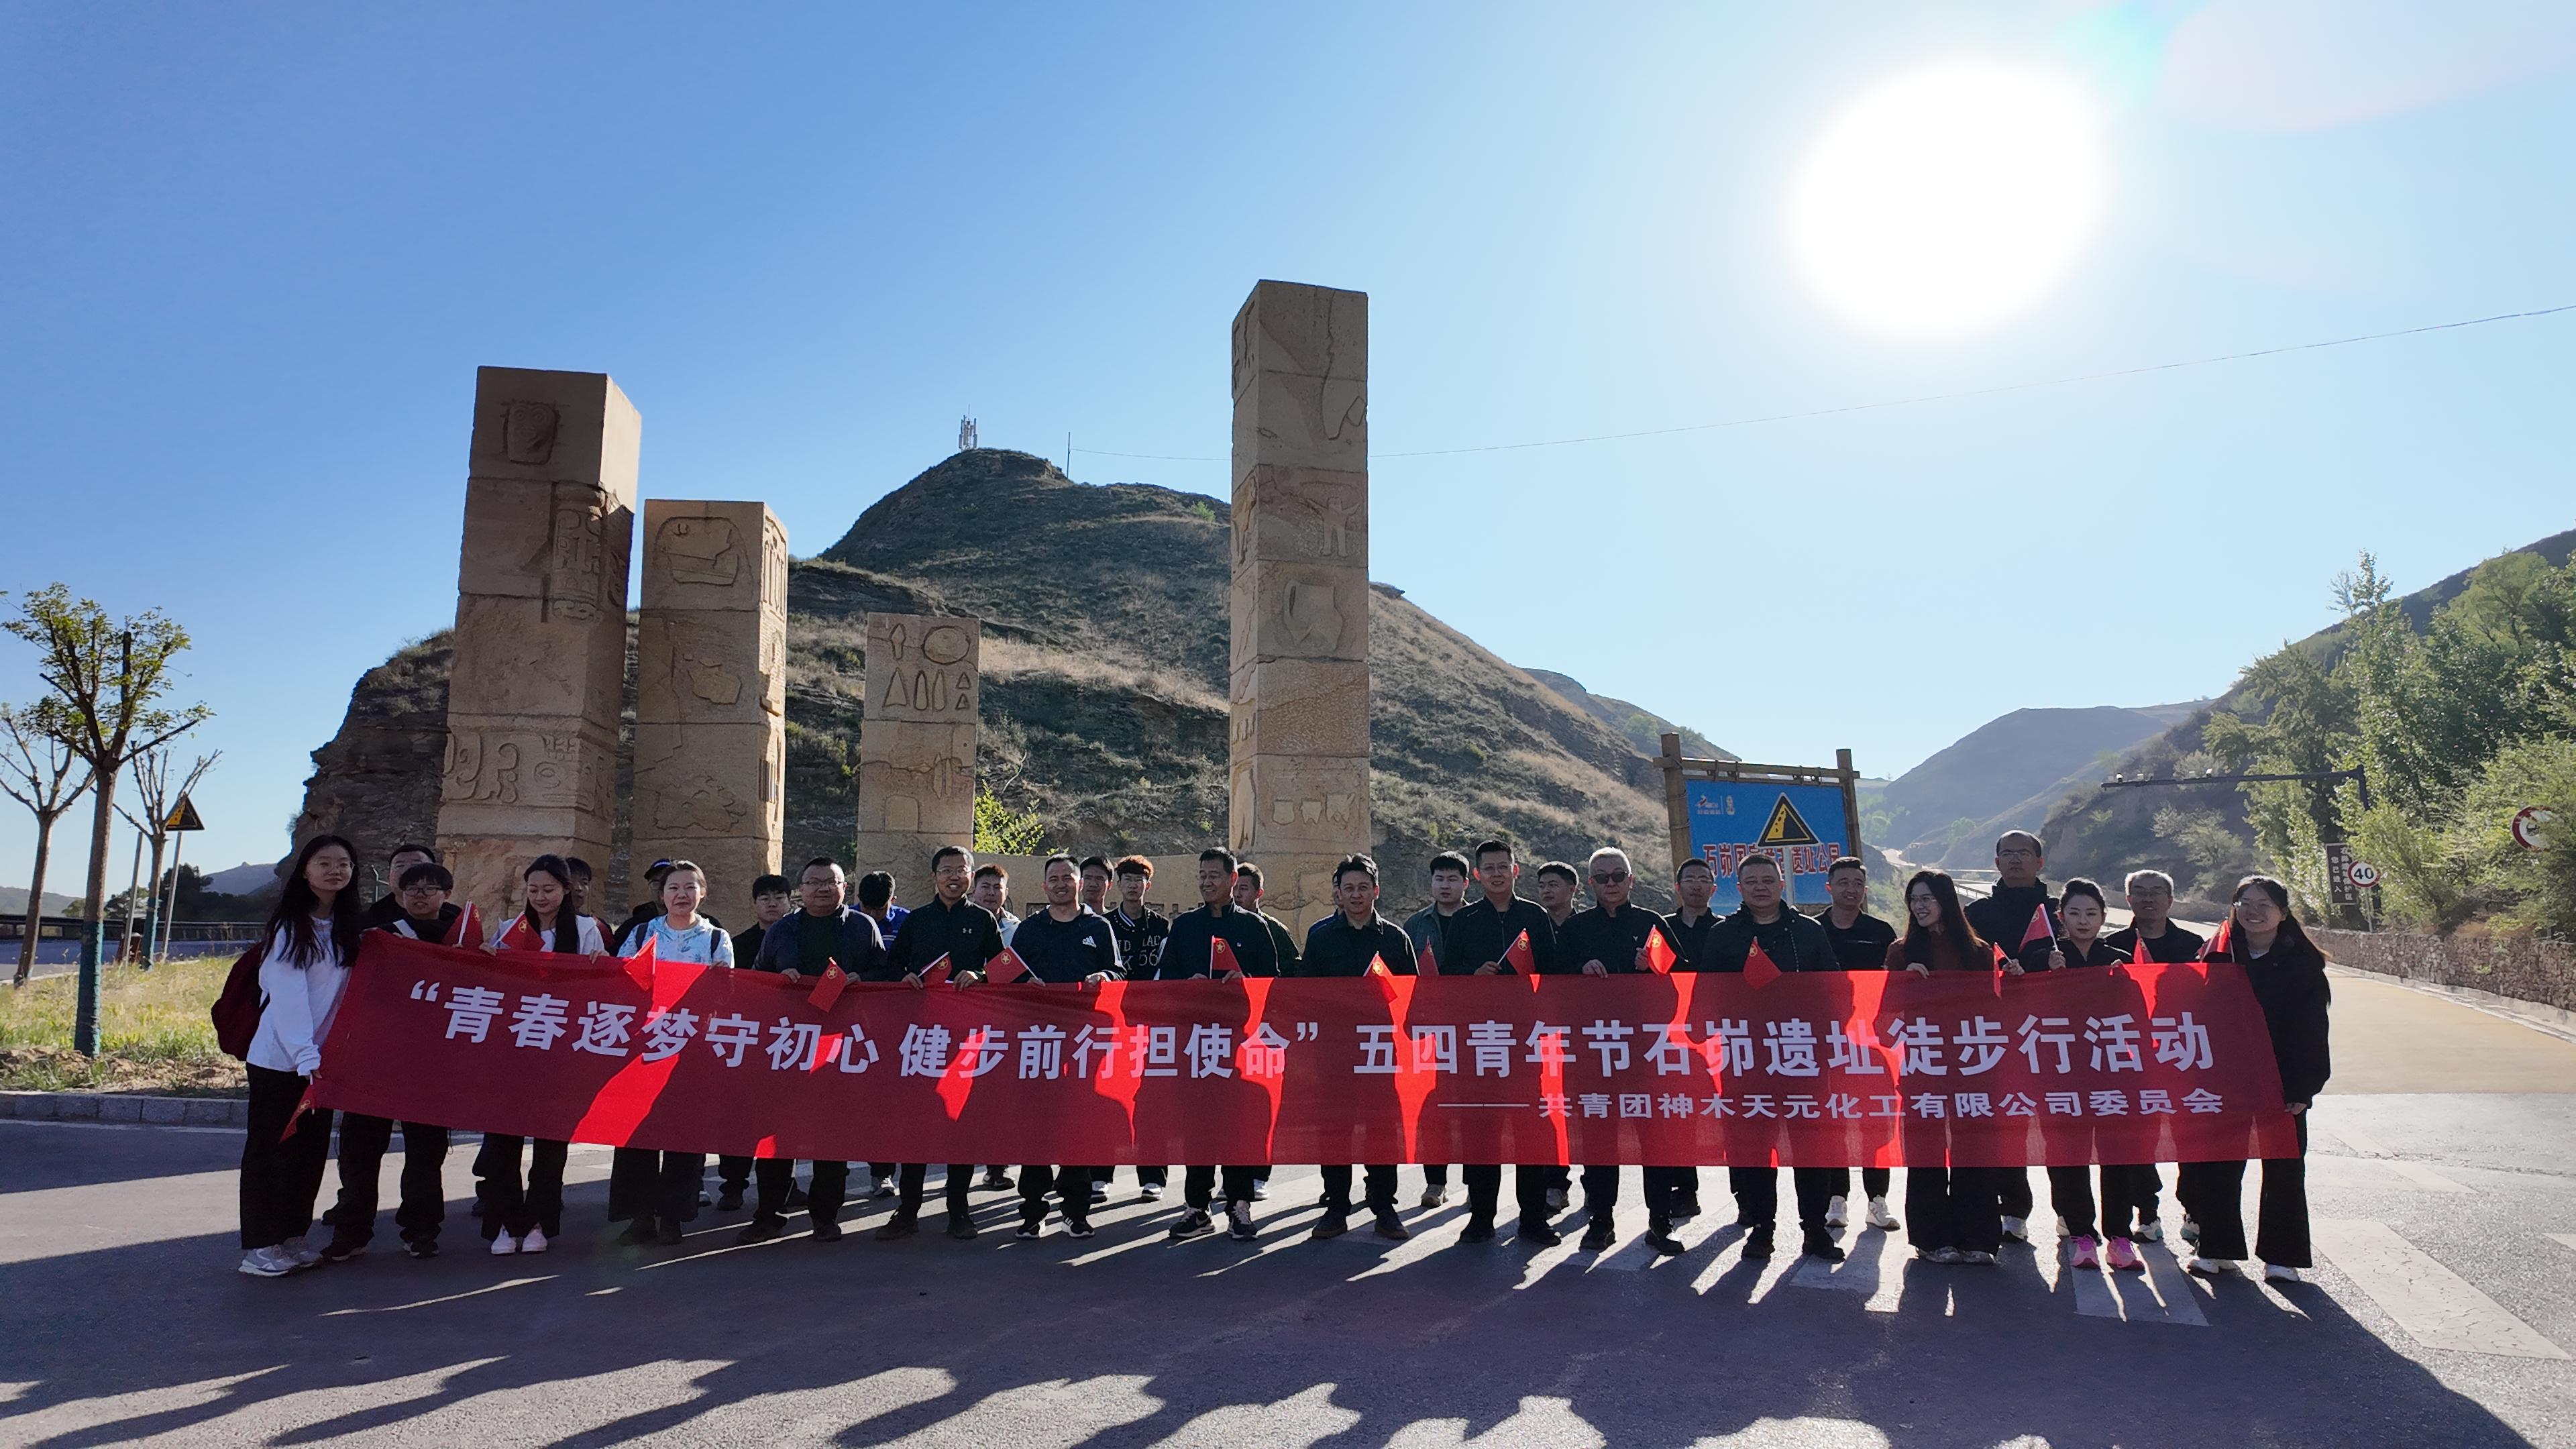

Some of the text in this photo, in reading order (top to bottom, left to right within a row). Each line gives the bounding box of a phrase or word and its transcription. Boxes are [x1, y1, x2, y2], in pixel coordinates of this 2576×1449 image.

[2353, 867, 2374, 879] 40
[410, 979, 2214, 1079] “青春逐梦守初心 健步前行担使命” 五四青年节石峁遗址徒步行活动
